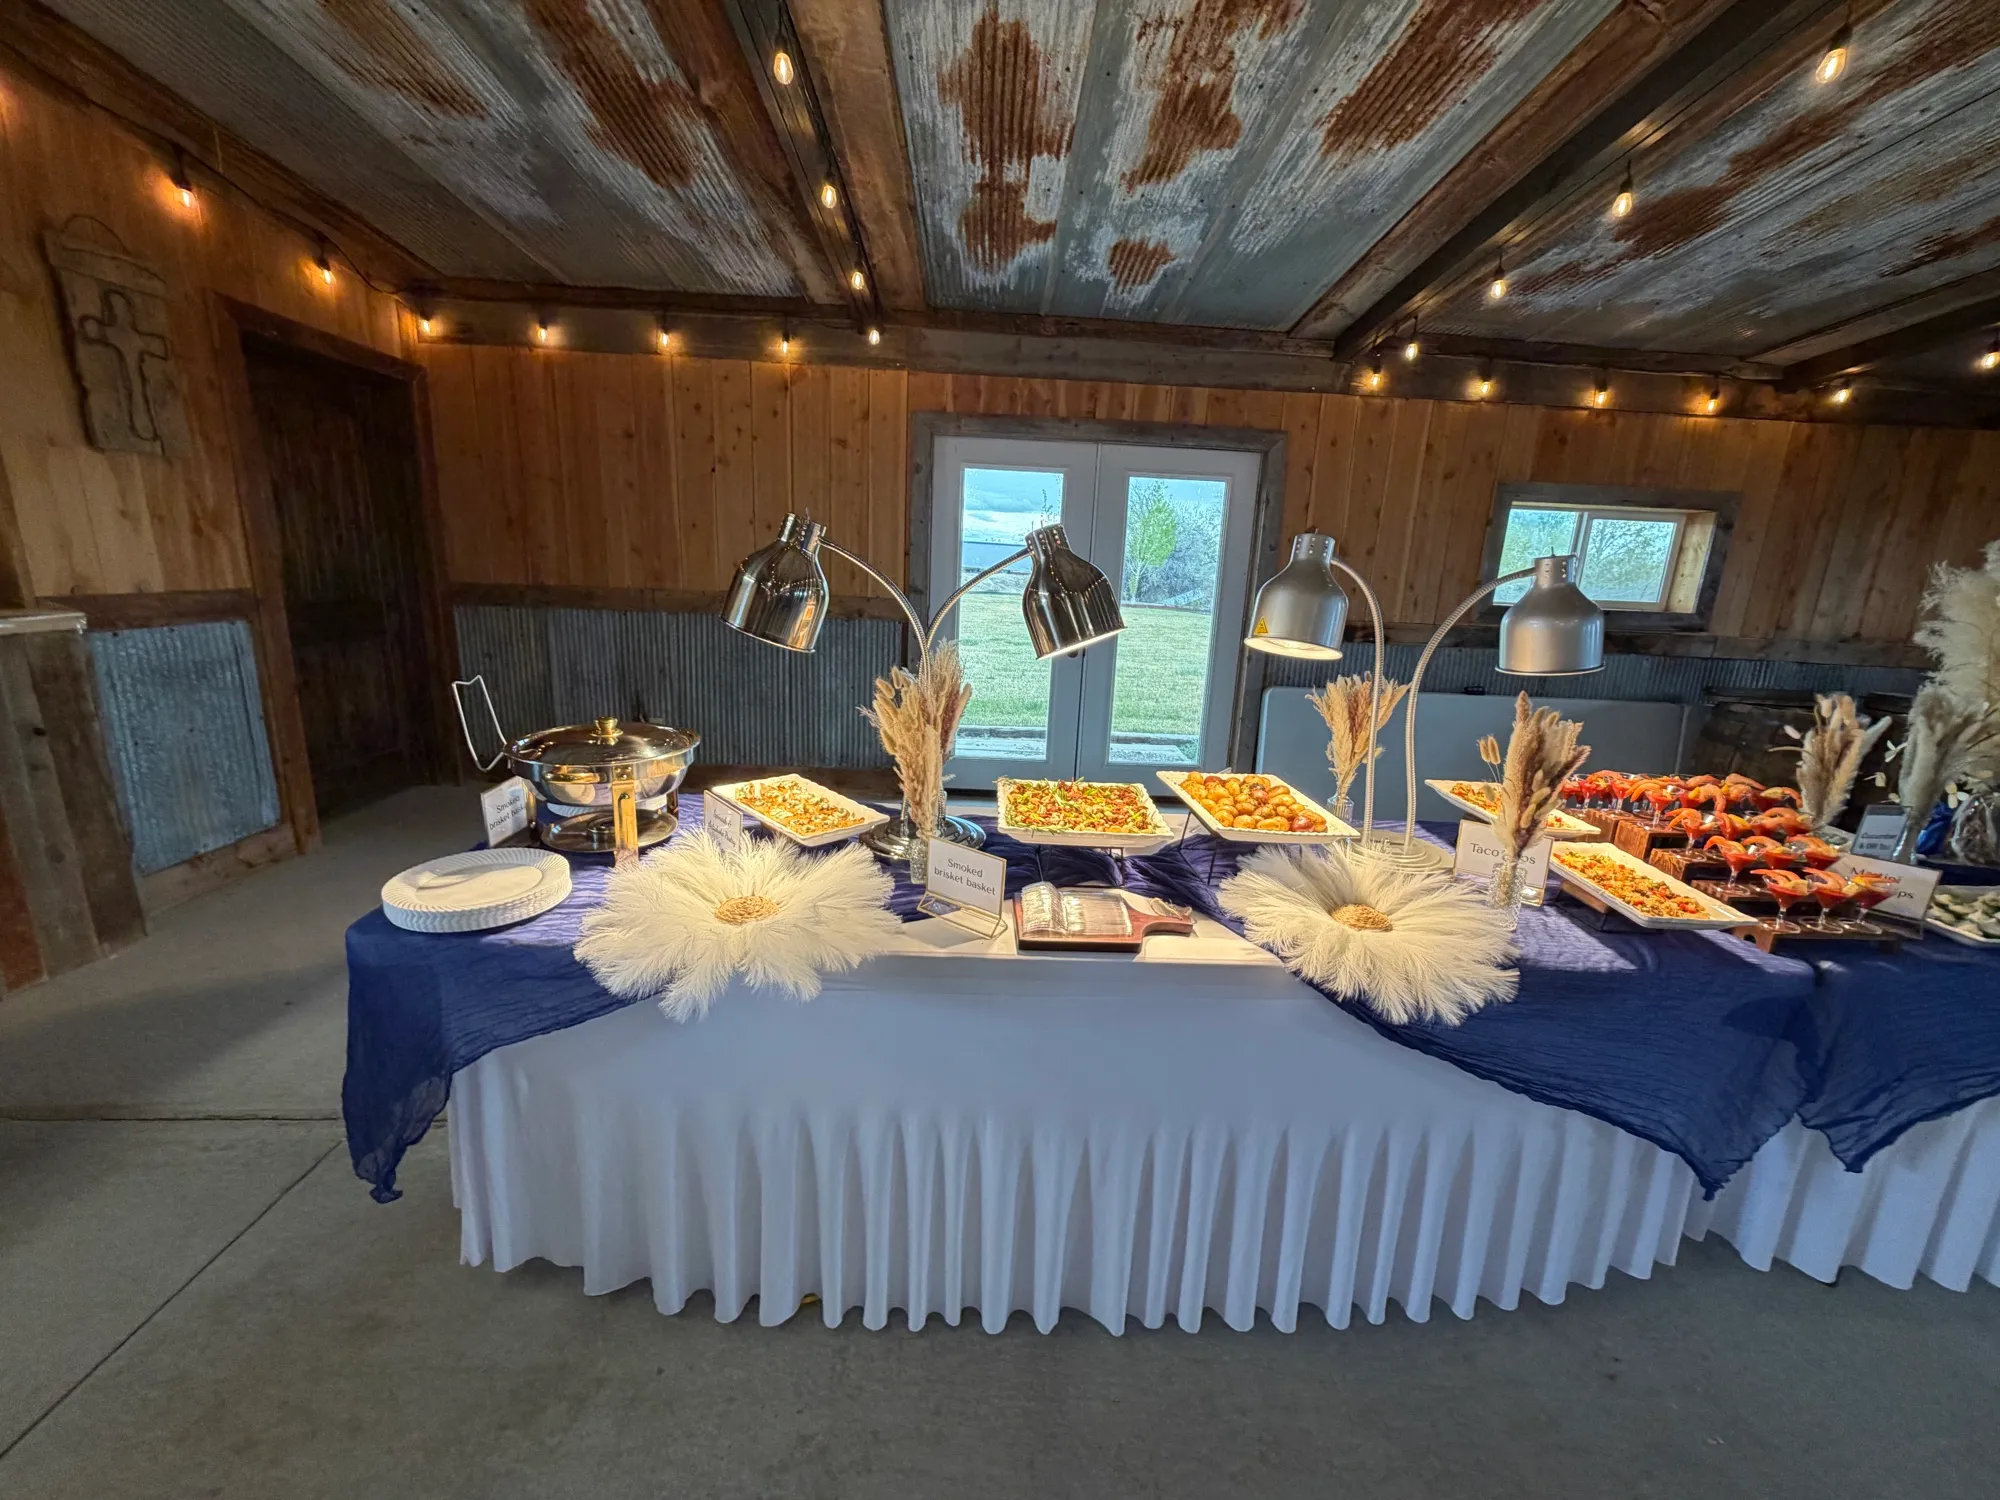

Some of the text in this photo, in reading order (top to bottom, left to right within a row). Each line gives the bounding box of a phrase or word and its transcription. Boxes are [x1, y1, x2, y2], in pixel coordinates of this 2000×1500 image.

[1470, 842, 1500, 857] Taco
[947, 858, 983, 878] Smoked
[934, 866, 996, 896] brisket basket
